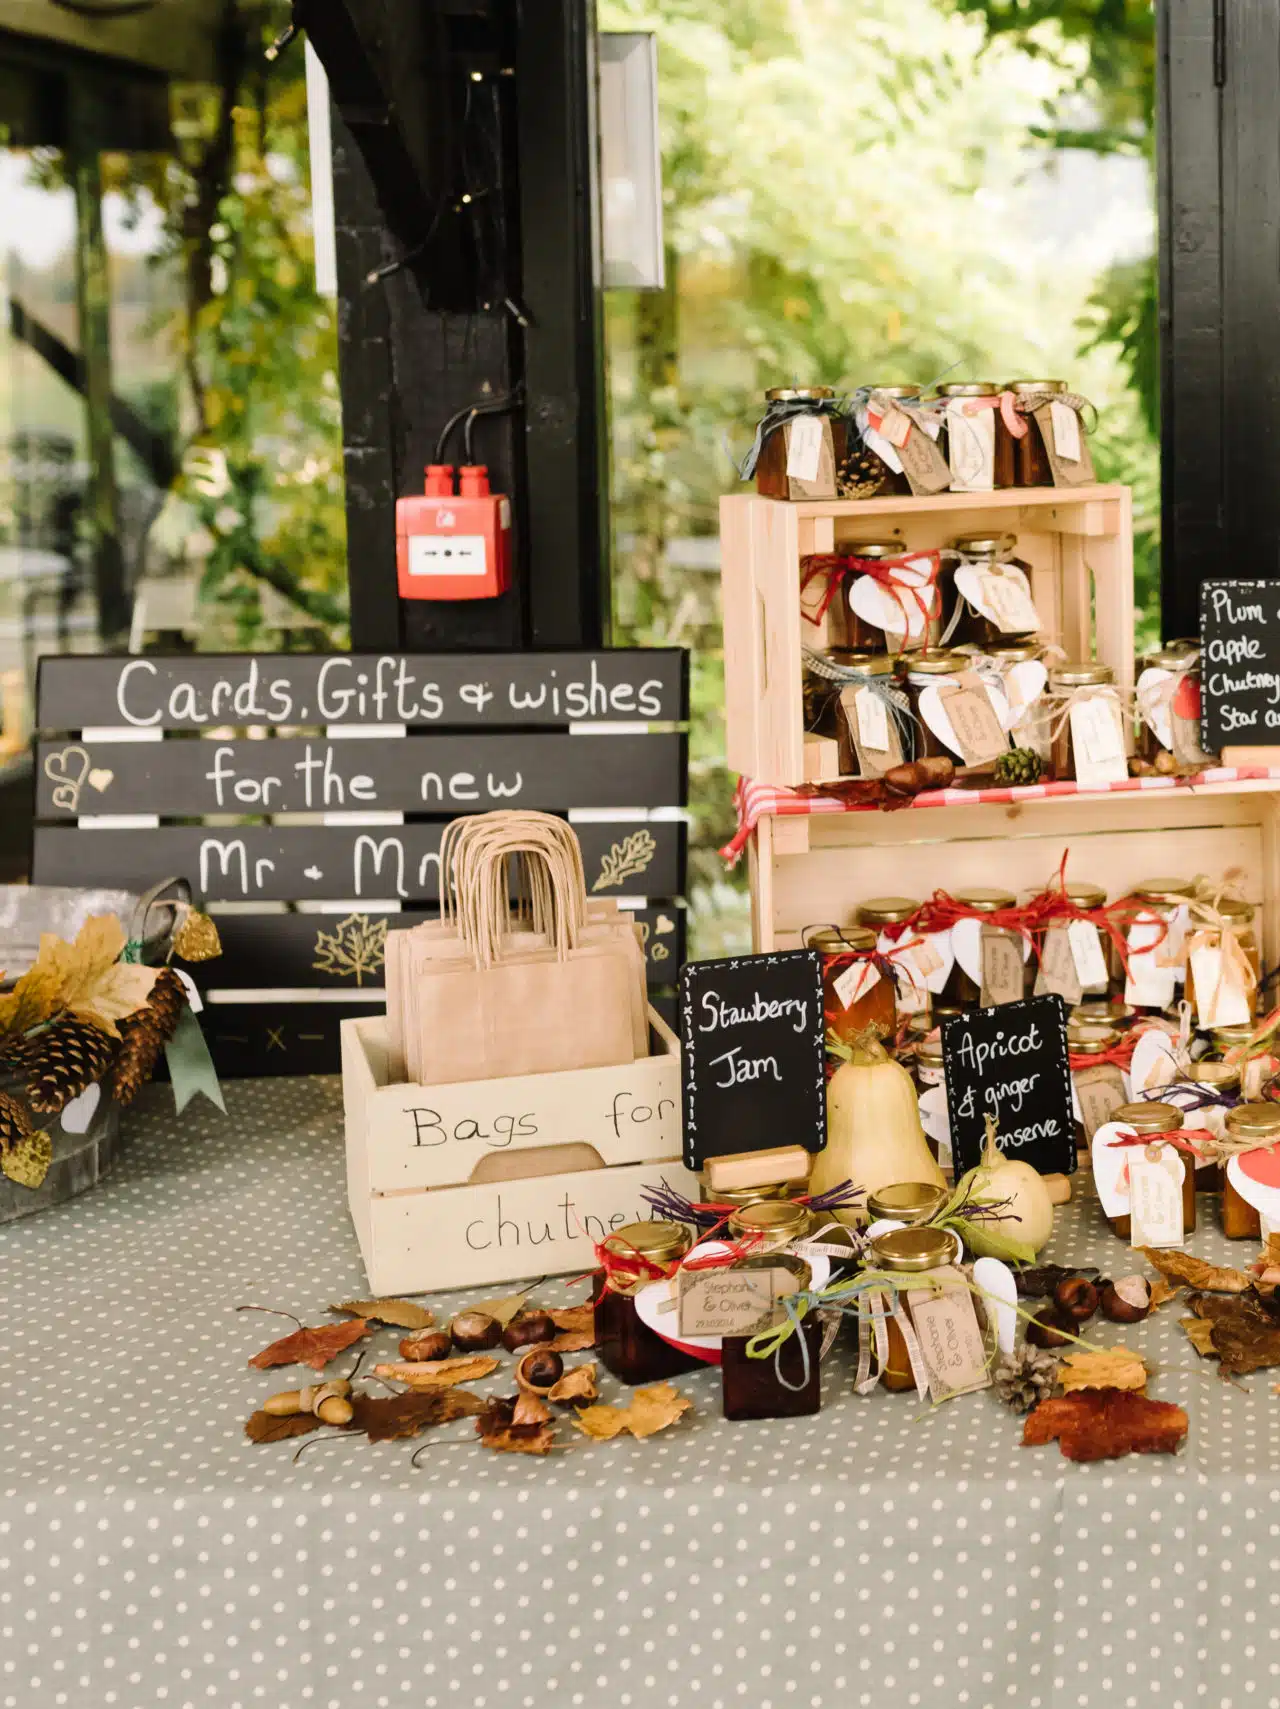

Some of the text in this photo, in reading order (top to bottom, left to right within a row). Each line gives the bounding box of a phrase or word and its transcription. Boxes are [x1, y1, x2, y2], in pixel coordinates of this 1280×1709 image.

[1211, 589, 1267, 624] Plum
[317, 656, 443, 720] Gifts
[509, 659, 664, 717] wishes
[1208, 671, 1280, 704] Chutney
[294, 744, 377, 807] the
[421, 771, 523, 800] new
[200, 839, 275, 894] Mr
[354, 835, 456, 898] Mr
[699, 990, 807, 1033] Stawberry
[708, 1046, 783, 1088] Jam
[957, 1023, 1043, 1076] Apricot
[402, 1092, 675, 1147] Bags for
[957, 1085, 977, 1119] &
[985, 1073, 1040, 1121] ginger
[466, 1192, 656, 1250] chutne
